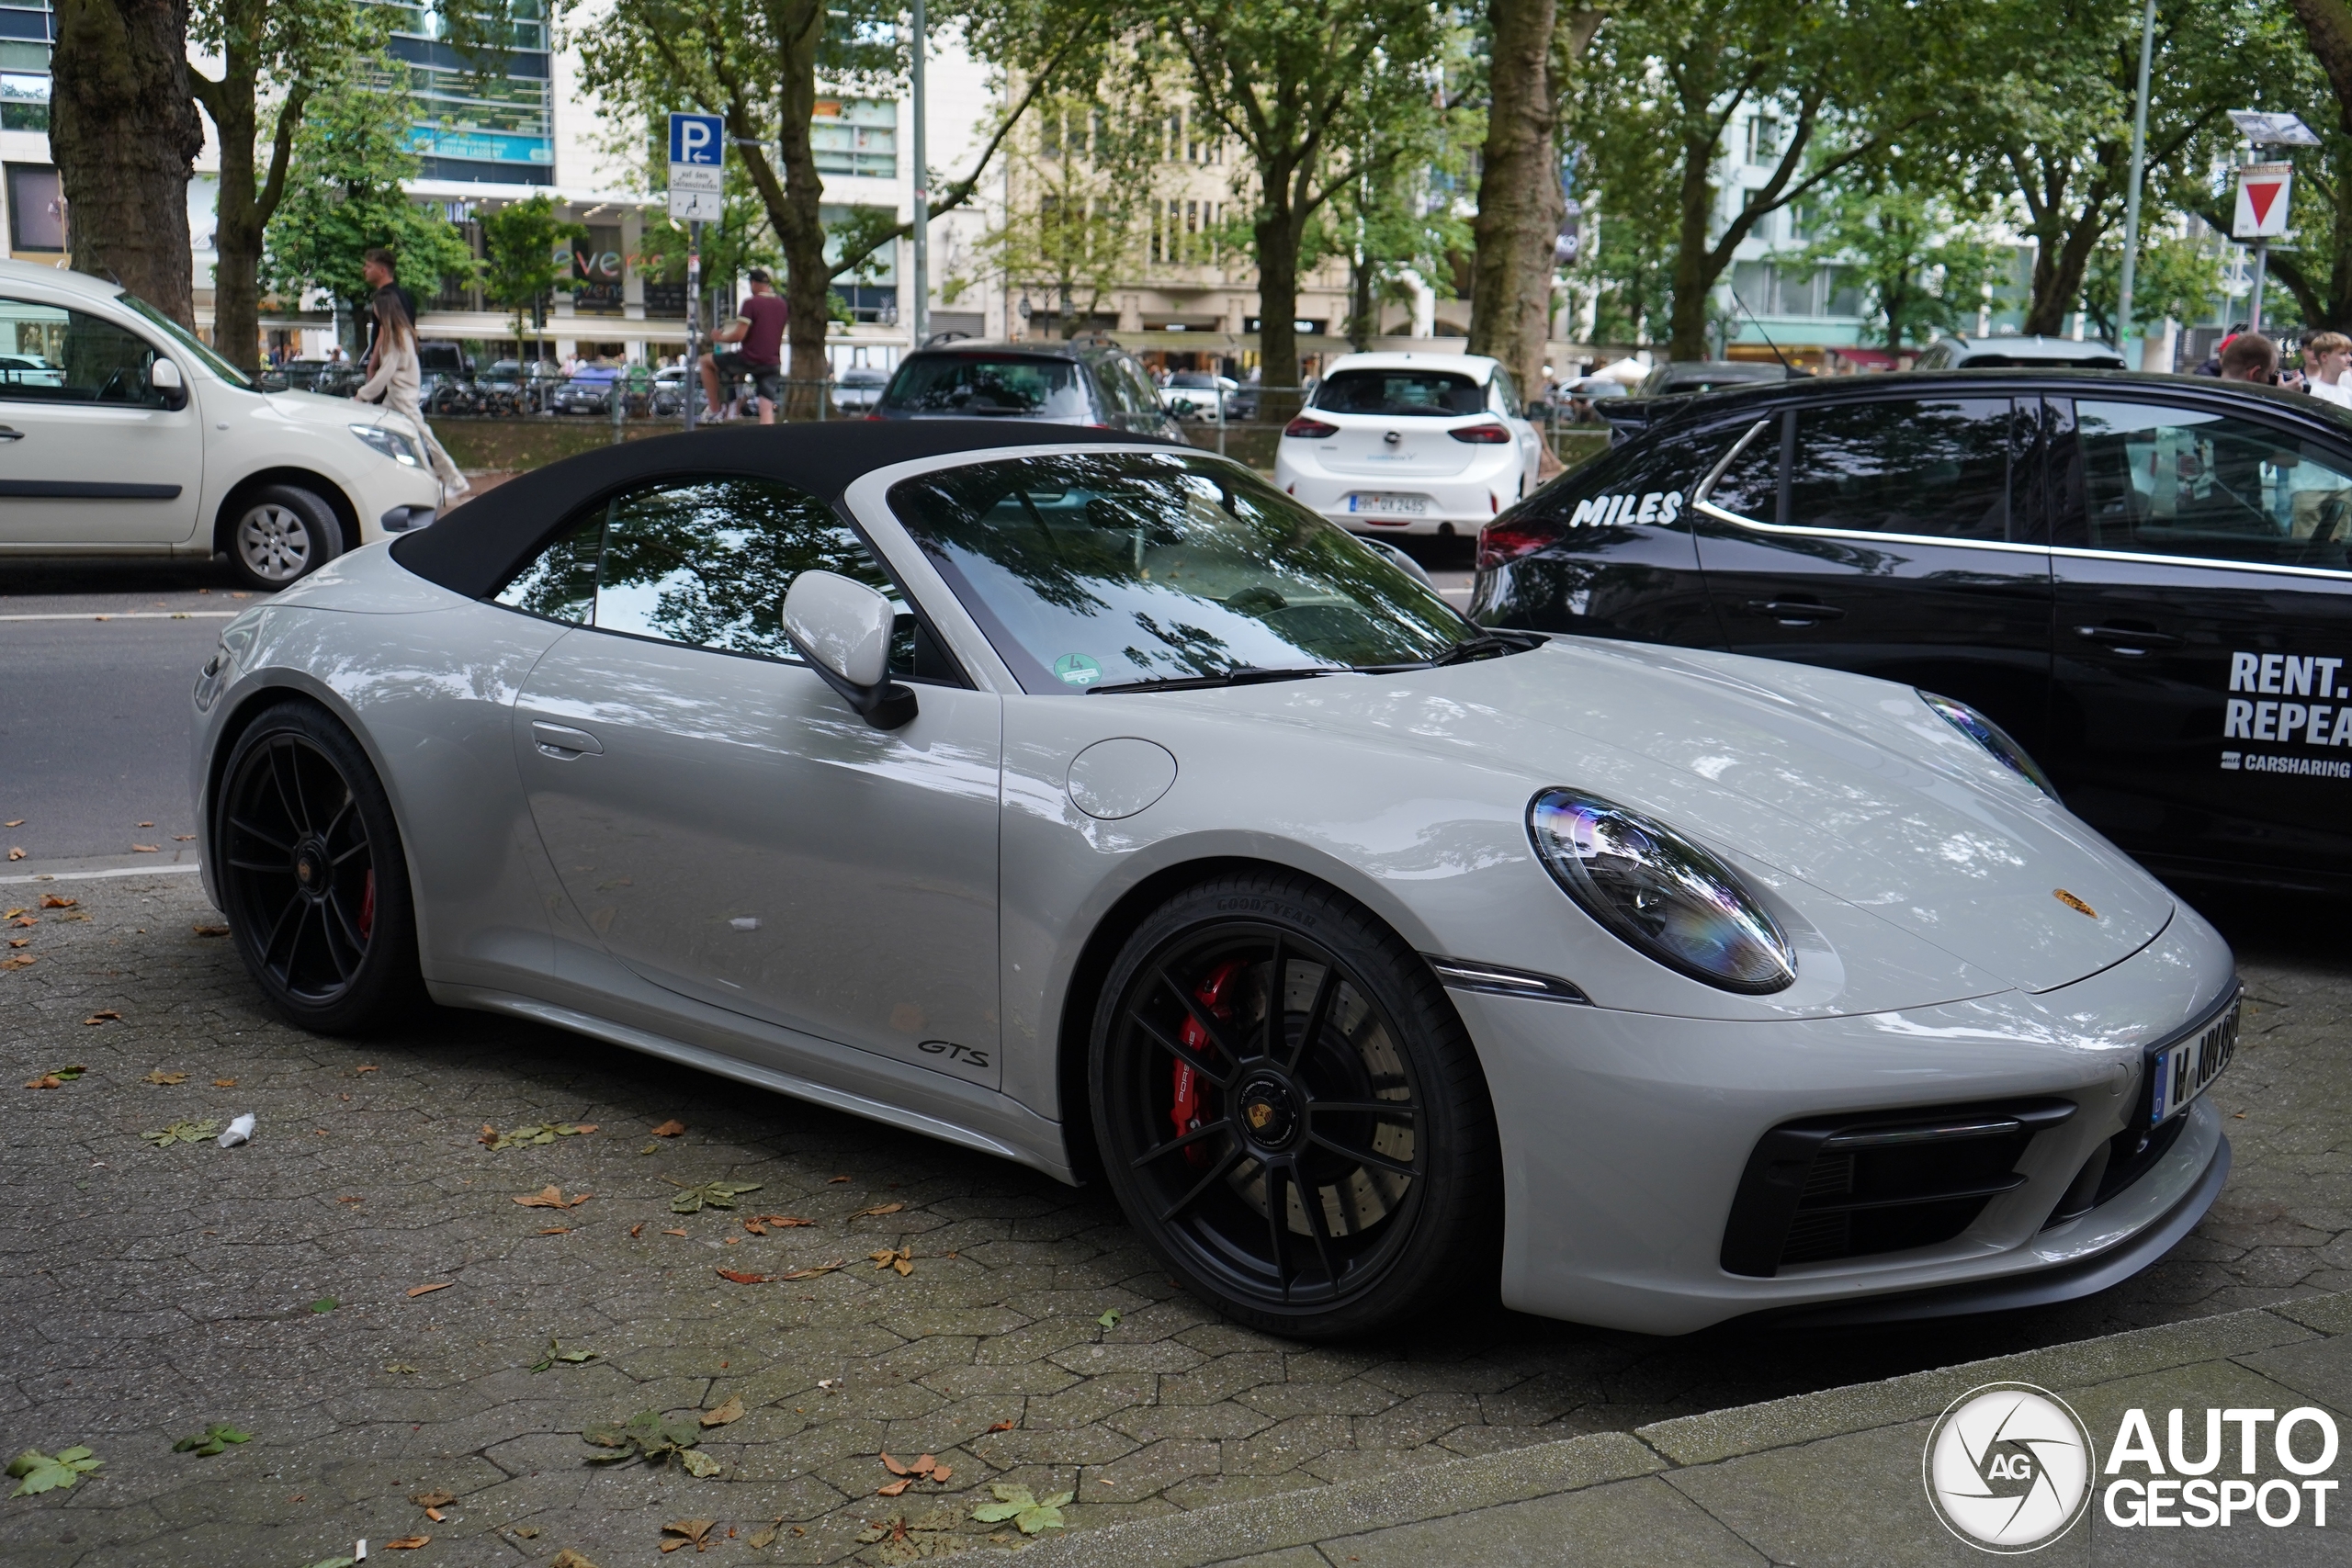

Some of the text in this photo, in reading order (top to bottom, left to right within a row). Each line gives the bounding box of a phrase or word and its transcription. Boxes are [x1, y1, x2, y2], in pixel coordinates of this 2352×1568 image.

[682, 119, 711, 162] P
[695, 171, 709, 179] dem
[1568, 491, 1683, 528] MILES
[1069, 654, 1083, 670] 4
[2229, 651, 2349, 699] RENT.
[2245, 753, 2352, 779] CARSHARING
[918, 1040, 989, 1067] GTS
